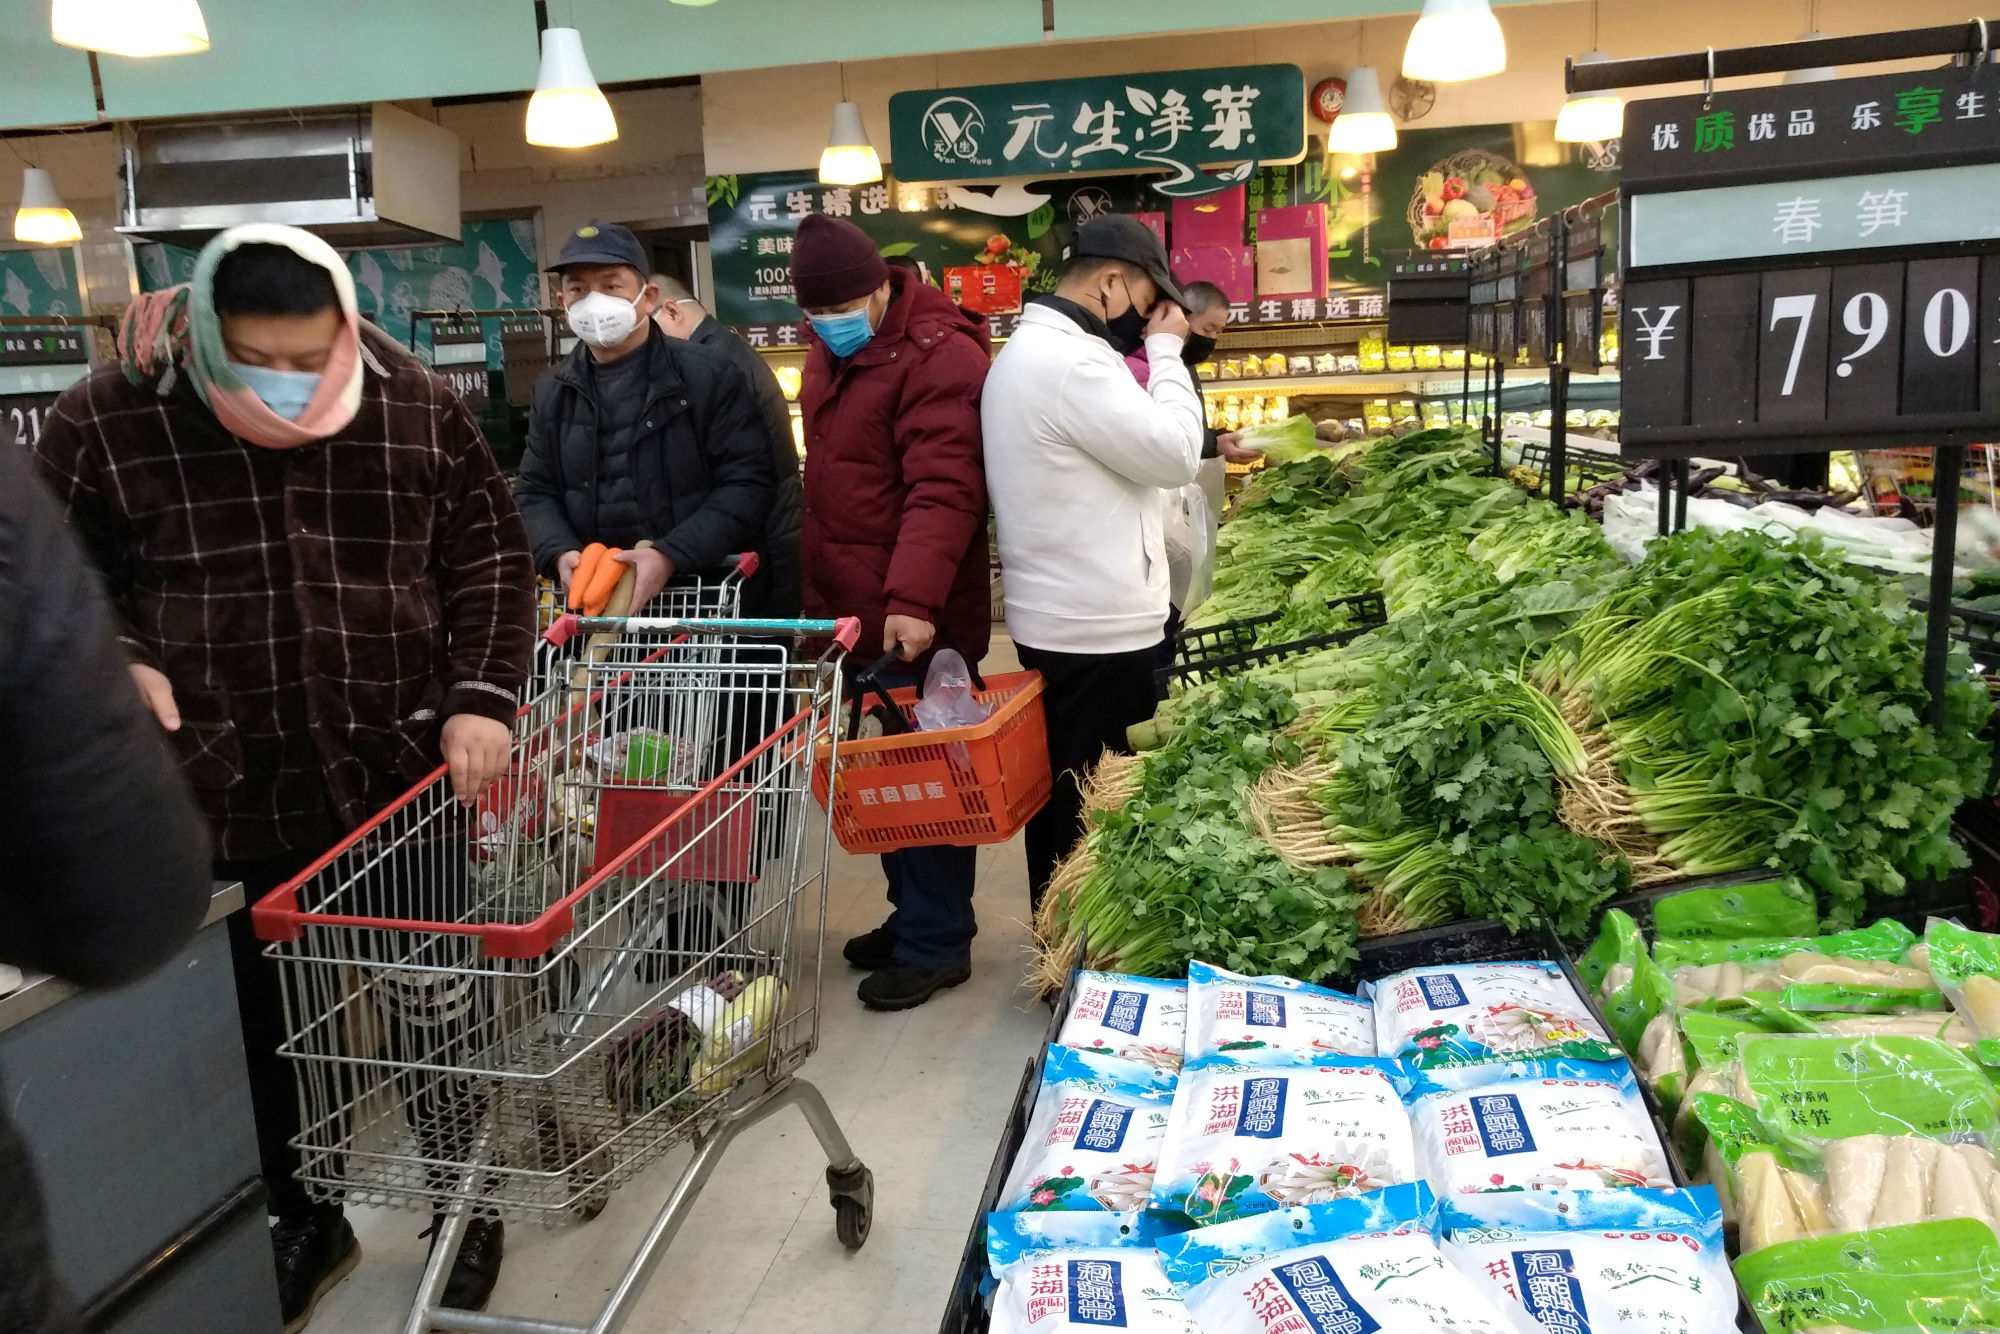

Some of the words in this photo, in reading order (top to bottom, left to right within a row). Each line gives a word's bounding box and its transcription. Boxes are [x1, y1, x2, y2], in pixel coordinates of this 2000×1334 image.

[1003, 84, 1260, 163] 元生净菜
[1652, 109, 1815, 153] 优质优品
[1851, 86, 1999, 134] 乐享生
[1772, 188, 1909, 244] 春笋
[747, 325, 798, 347] 元生
[1631, 305, 1681, 360] ¥
[1769, 288, 1971, 396] 7.90
[10, 406, 53, 446] 21
[1210, 1085, 1240, 1121] 洪湖
[1440, 1103, 1474, 1137] 洪湖
[1031, 1264, 1064, 1296] 洪湖
[1243, 1276, 1294, 1327] 洪湖
